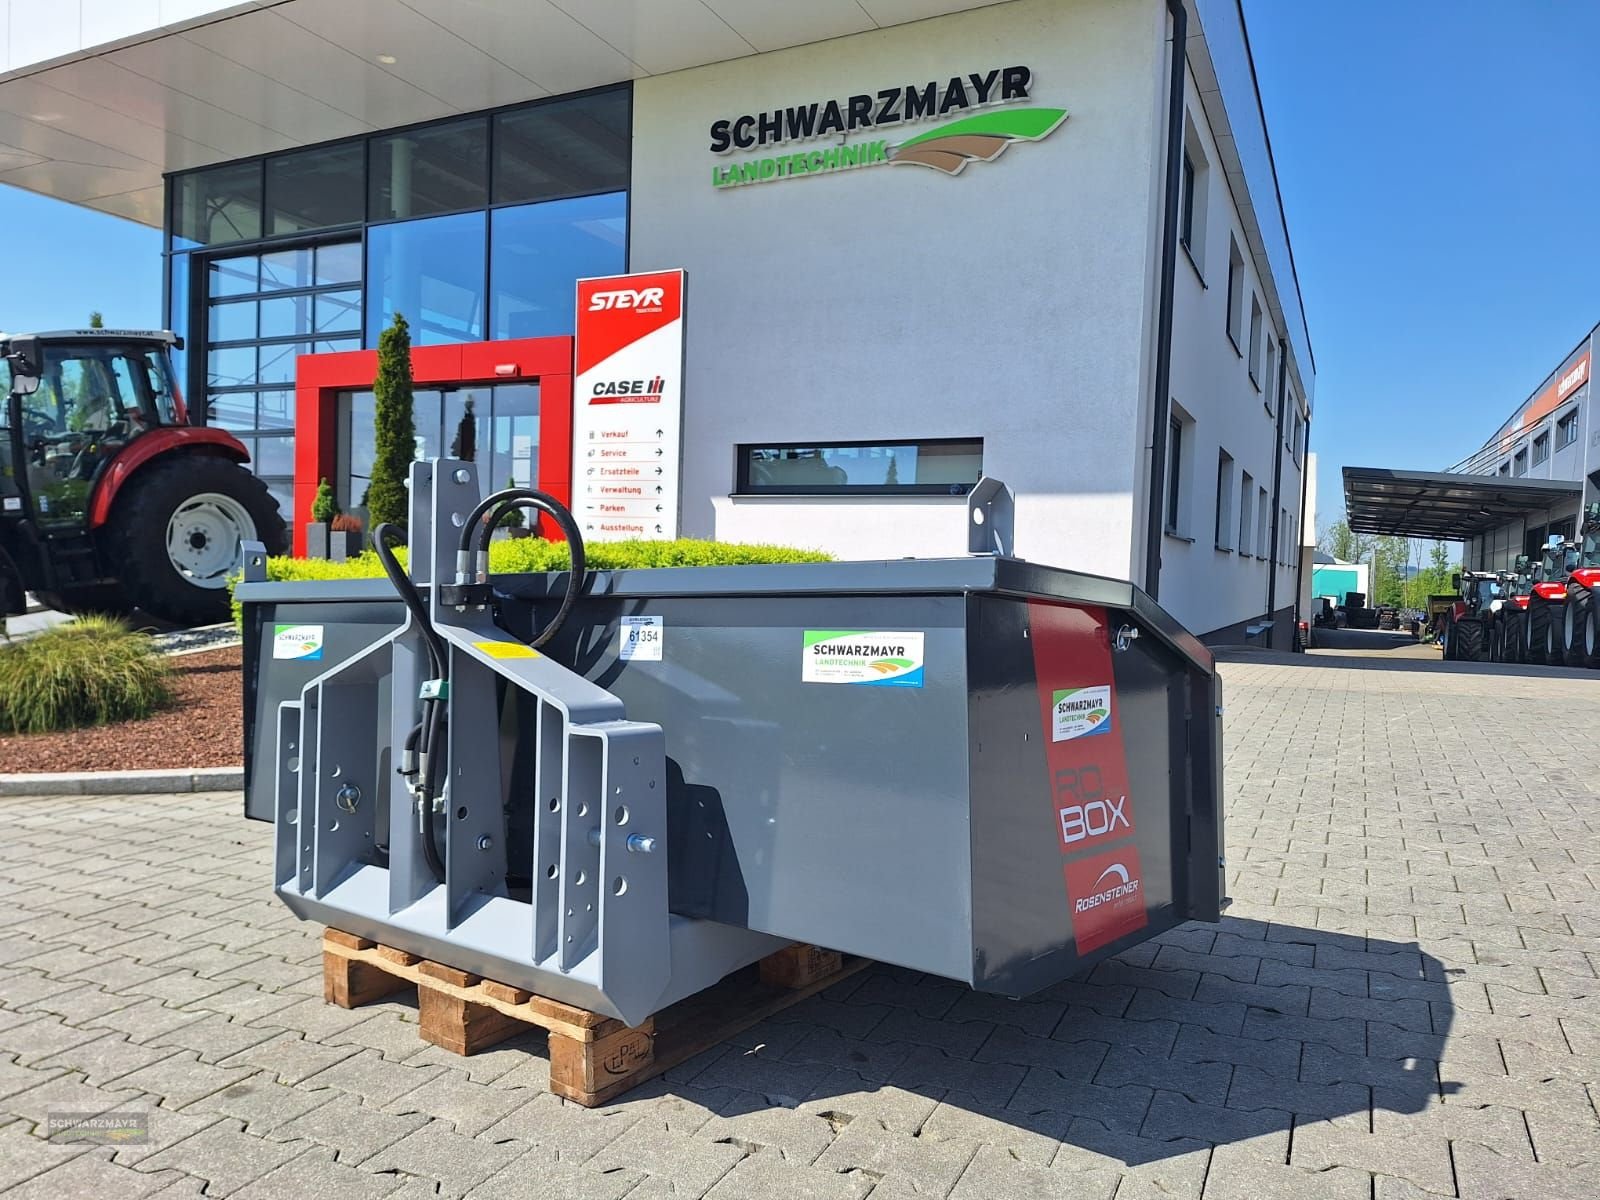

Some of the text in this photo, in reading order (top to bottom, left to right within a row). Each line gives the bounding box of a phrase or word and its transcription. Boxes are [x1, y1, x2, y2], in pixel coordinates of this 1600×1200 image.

[709, 65, 1032, 154] SCHWARZMAYR
[712, 139, 888, 188] LANDTECHNIK
[588, 287, 664, 312] STEYR
[592, 380, 644, 396] CASE
[601, 430, 629, 438] Verkauf
[600, 449, 627, 457] Service
[600, 467, 640, 476] Ersatzteile
[600, 486, 642, 496] Verwaltung
[599, 504, 626, 512] Parken
[600, 523, 644, 534] Ausstellung
[629, 630, 658, 642] 61354
[813, 644, 905, 657] SCHWARZMAYR
[815, 658, 867, 667] LANDTECHNIK
[1058, 697, 1103, 714] SCHWARZMAYR
[1055, 766, 1104, 802] RO
[1059, 795, 1131, 844] BOX
[1074, 879, 1139, 914] ROSENSTEINER
